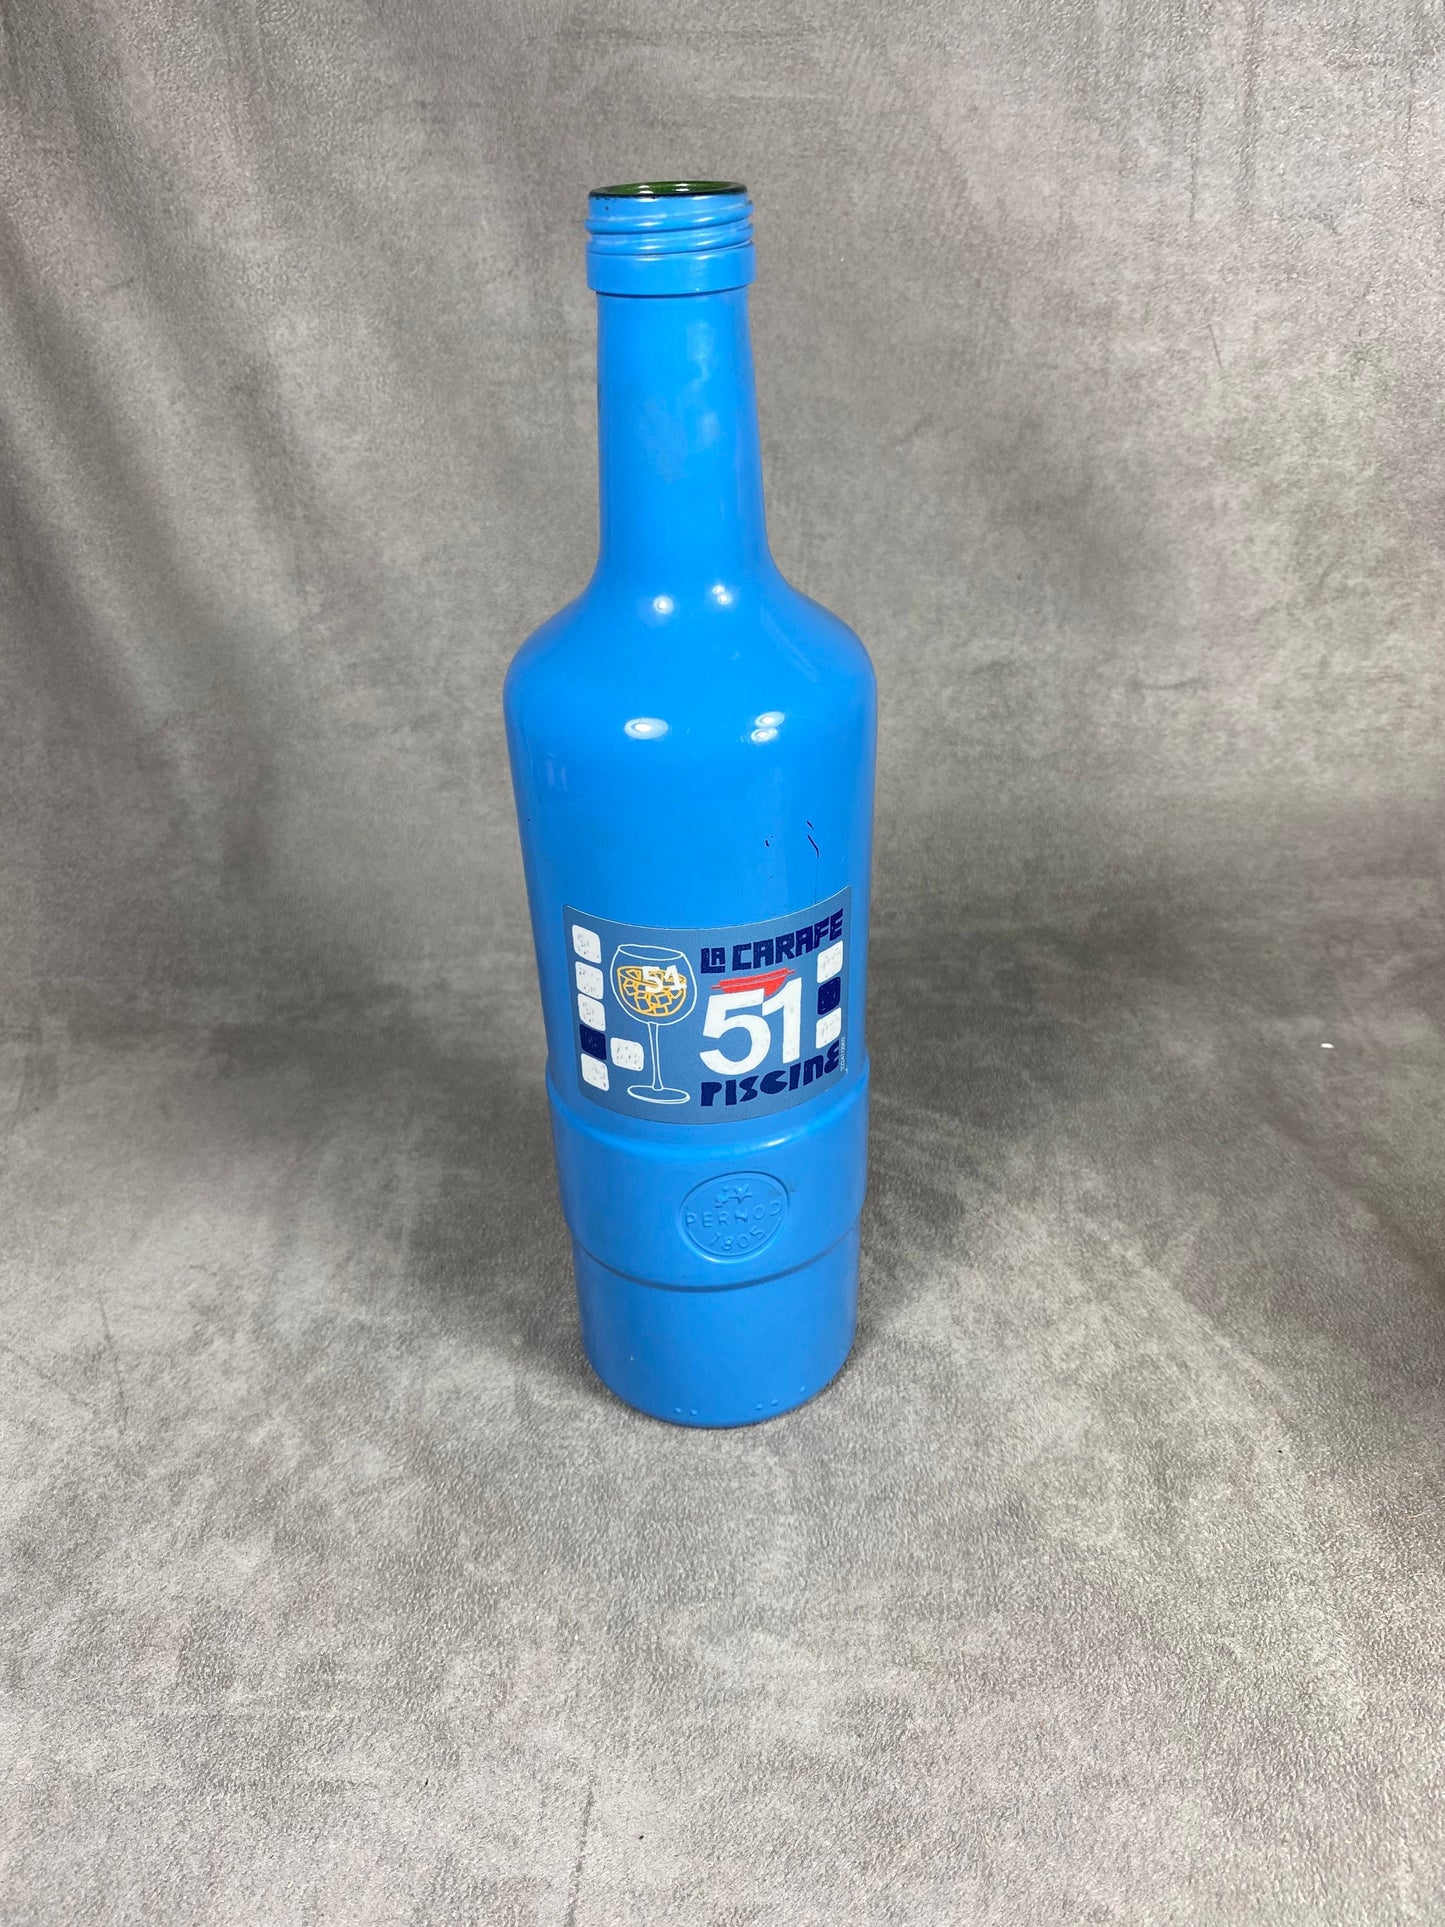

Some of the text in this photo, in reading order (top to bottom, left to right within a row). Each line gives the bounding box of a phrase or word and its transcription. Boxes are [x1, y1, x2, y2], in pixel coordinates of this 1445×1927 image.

[700, 908, 844, 974] LA CARAFE
[642, 965, 687, 993] 51
[700, 977, 802, 1075] 51
[685, 1200, 781, 1228] PERNOD
[709, 1225, 765, 1251] 1805
